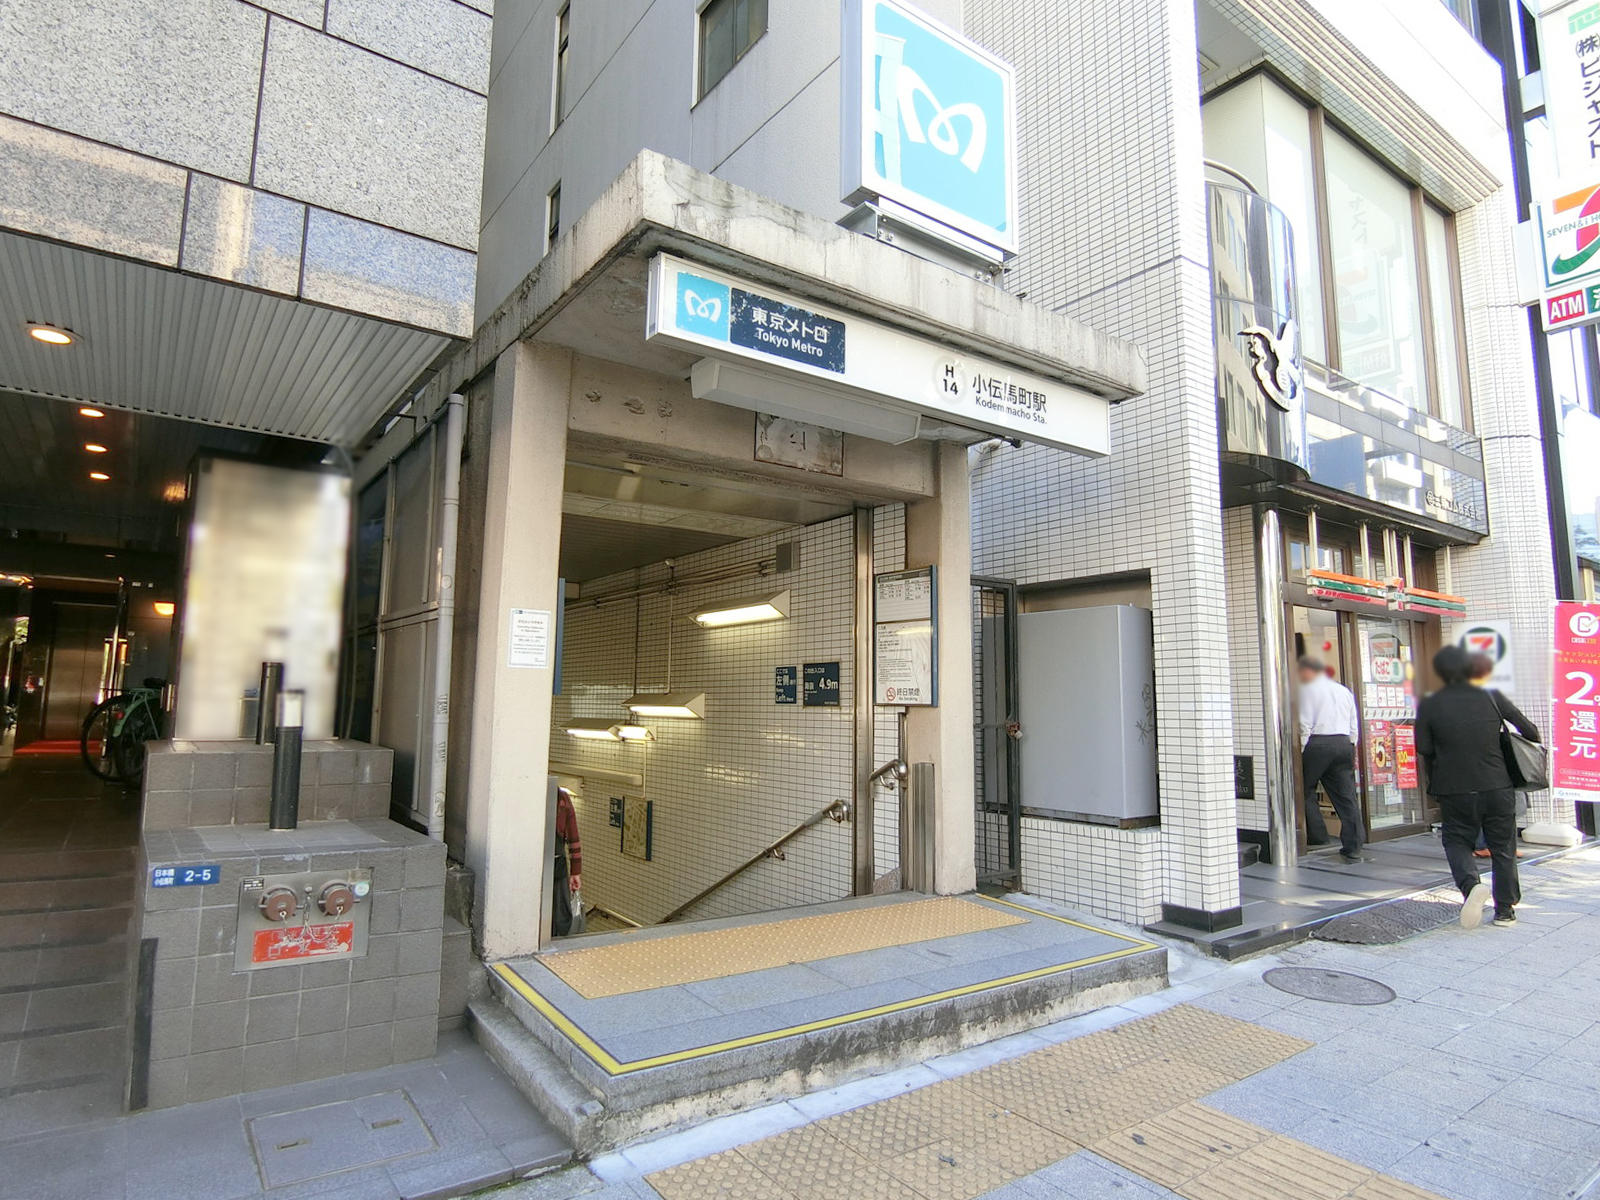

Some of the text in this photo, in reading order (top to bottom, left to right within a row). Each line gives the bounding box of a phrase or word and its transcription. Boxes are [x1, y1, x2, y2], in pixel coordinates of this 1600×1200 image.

[1547, 221, 1577, 239] SEVEN
[1551, 294, 1583, 321] ATM
[751, 306, 828, 344] 東京メトロ
[755, 327, 824, 357] Tokyo Metro
[945, 364, 954, 378] H
[943, 379, 959, 395] 14
[972, 373, 1048, 414] 小伝馬町駅
[1032, 413, 1048, 425] Sta.
[818, 677, 839, 690] 4.9m
[1569, 709, 1597, 759] 還元
[184, 868, 212, 882] 2-5
